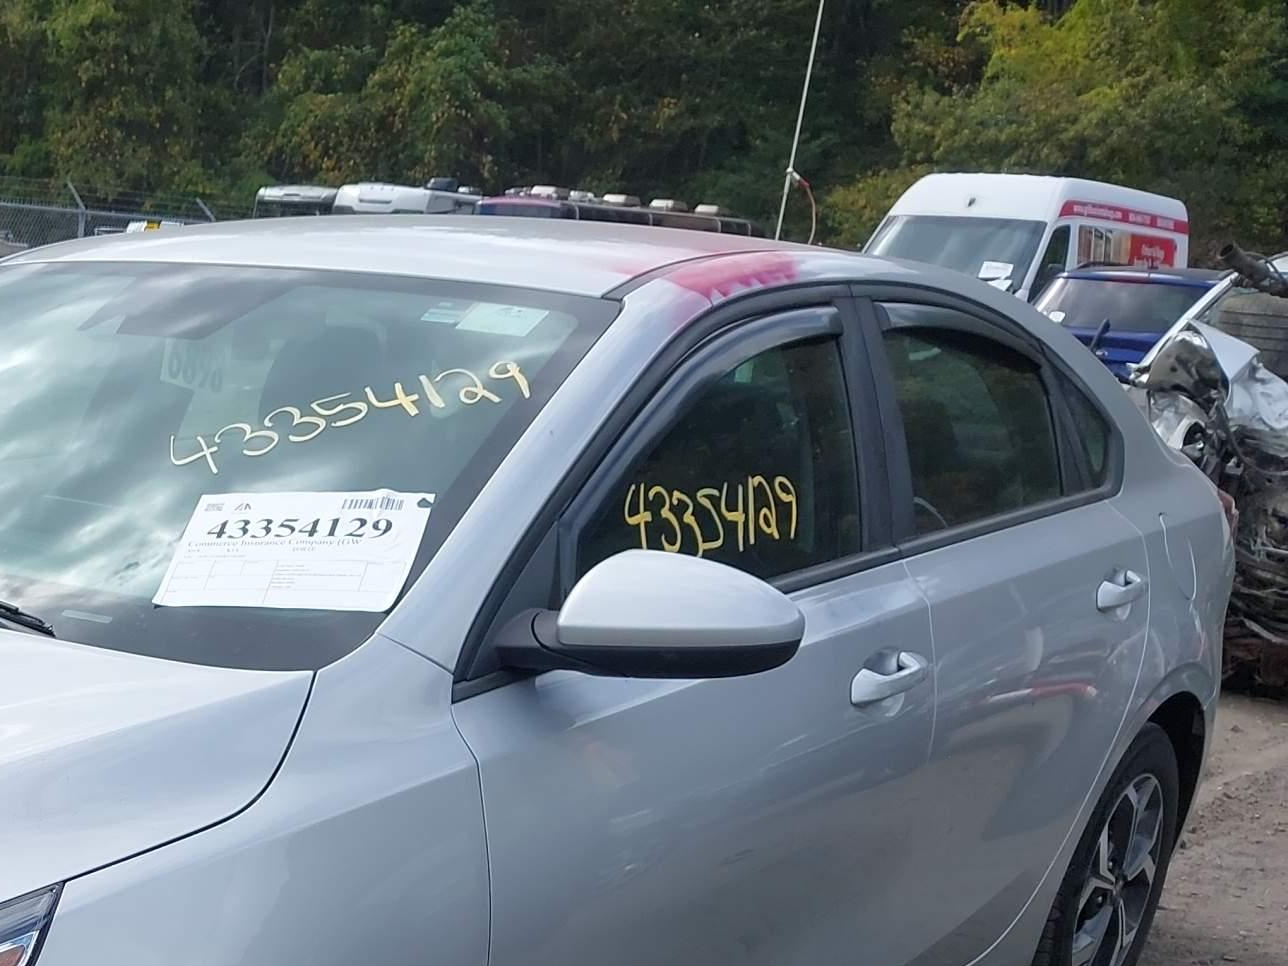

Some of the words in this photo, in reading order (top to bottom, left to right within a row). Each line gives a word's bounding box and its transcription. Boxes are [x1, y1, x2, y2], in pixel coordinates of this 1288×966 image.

[170, 361, 530, 474] 43354129
[206, 517, 393, 539] 43354129
[624, 475, 798, 558] 43354129
